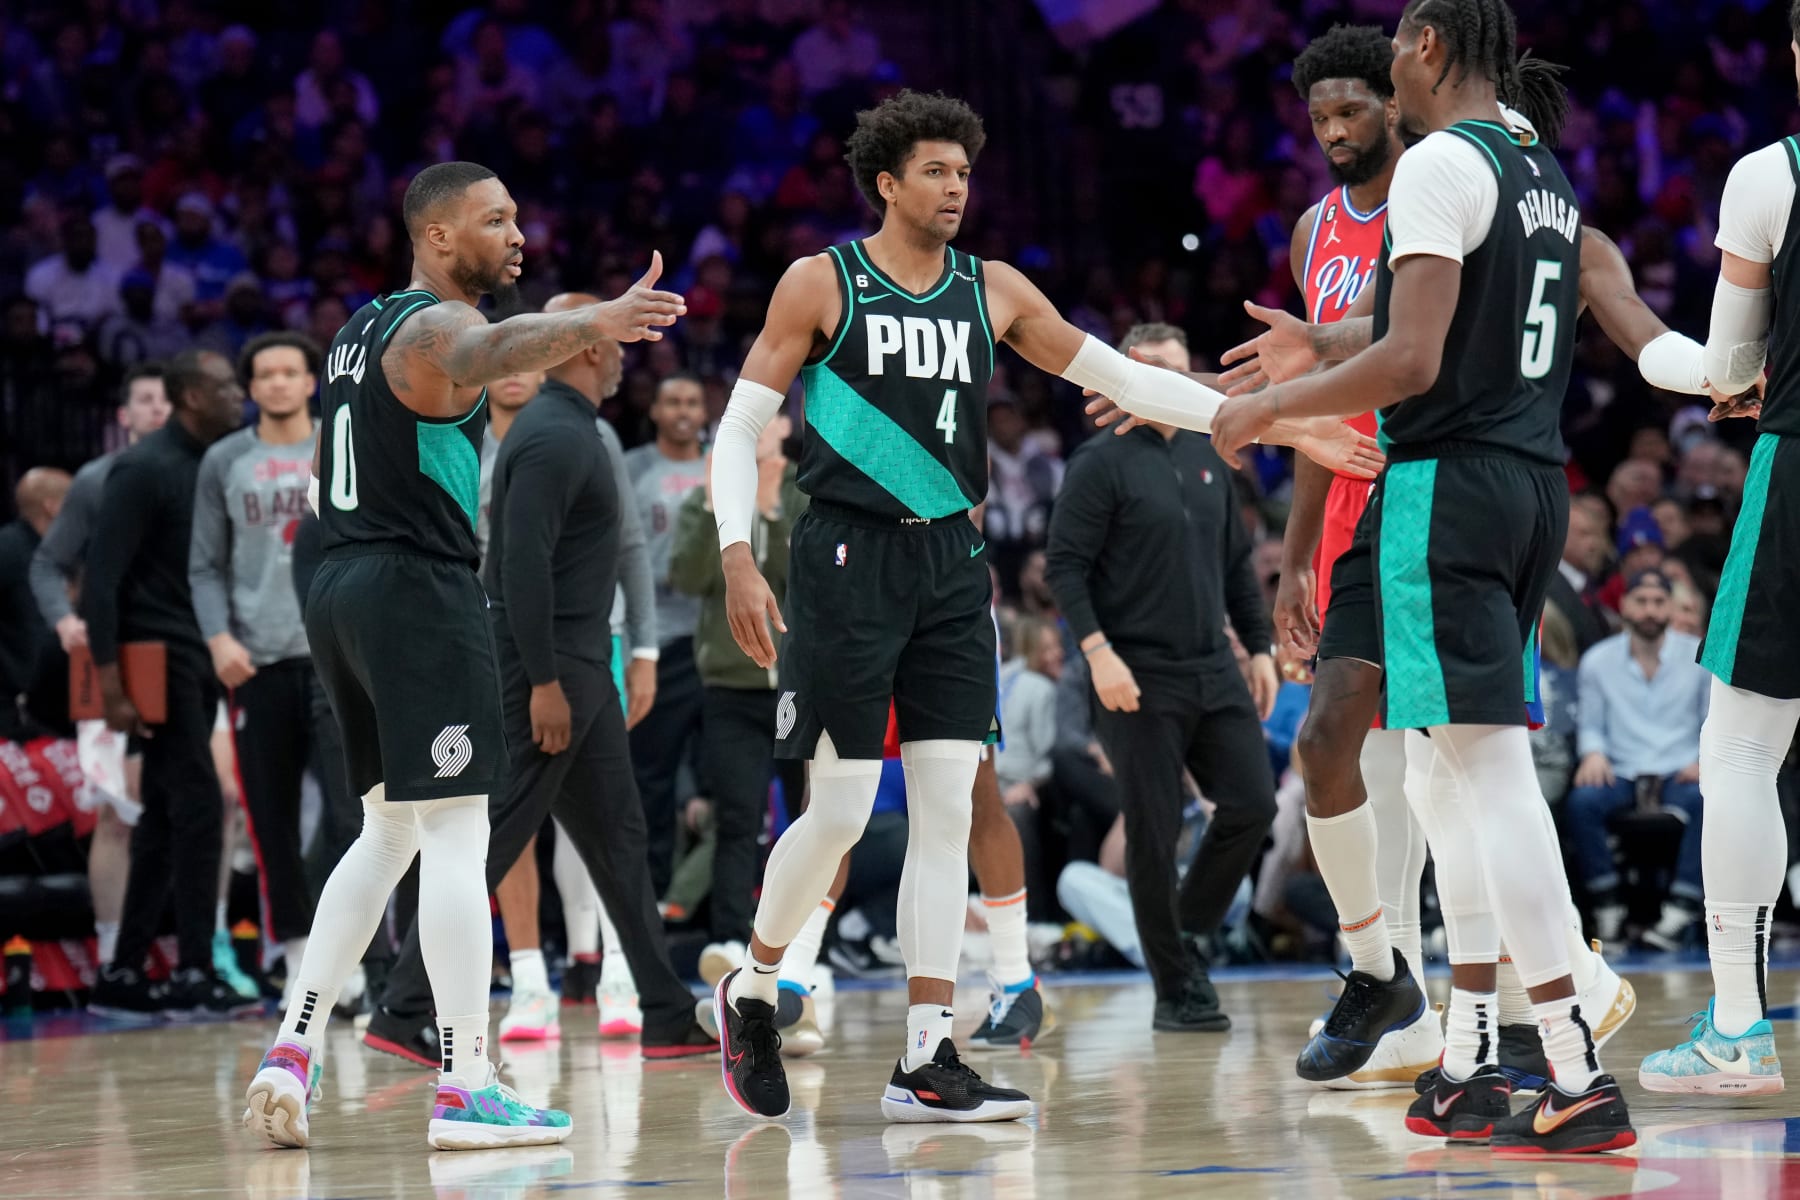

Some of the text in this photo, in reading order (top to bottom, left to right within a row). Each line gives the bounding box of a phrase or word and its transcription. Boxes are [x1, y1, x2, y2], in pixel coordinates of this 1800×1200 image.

[1326, 205, 1336, 222] 6
[1517, 189, 1579, 244] REDDISH
[855, 274, 869, 288] 6
[1520, 259, 1561, 379] 5
[865, 314, 973, 384] PDX
[935, 388, 958, 445] 4
[330, 403, 358, 511] 0
